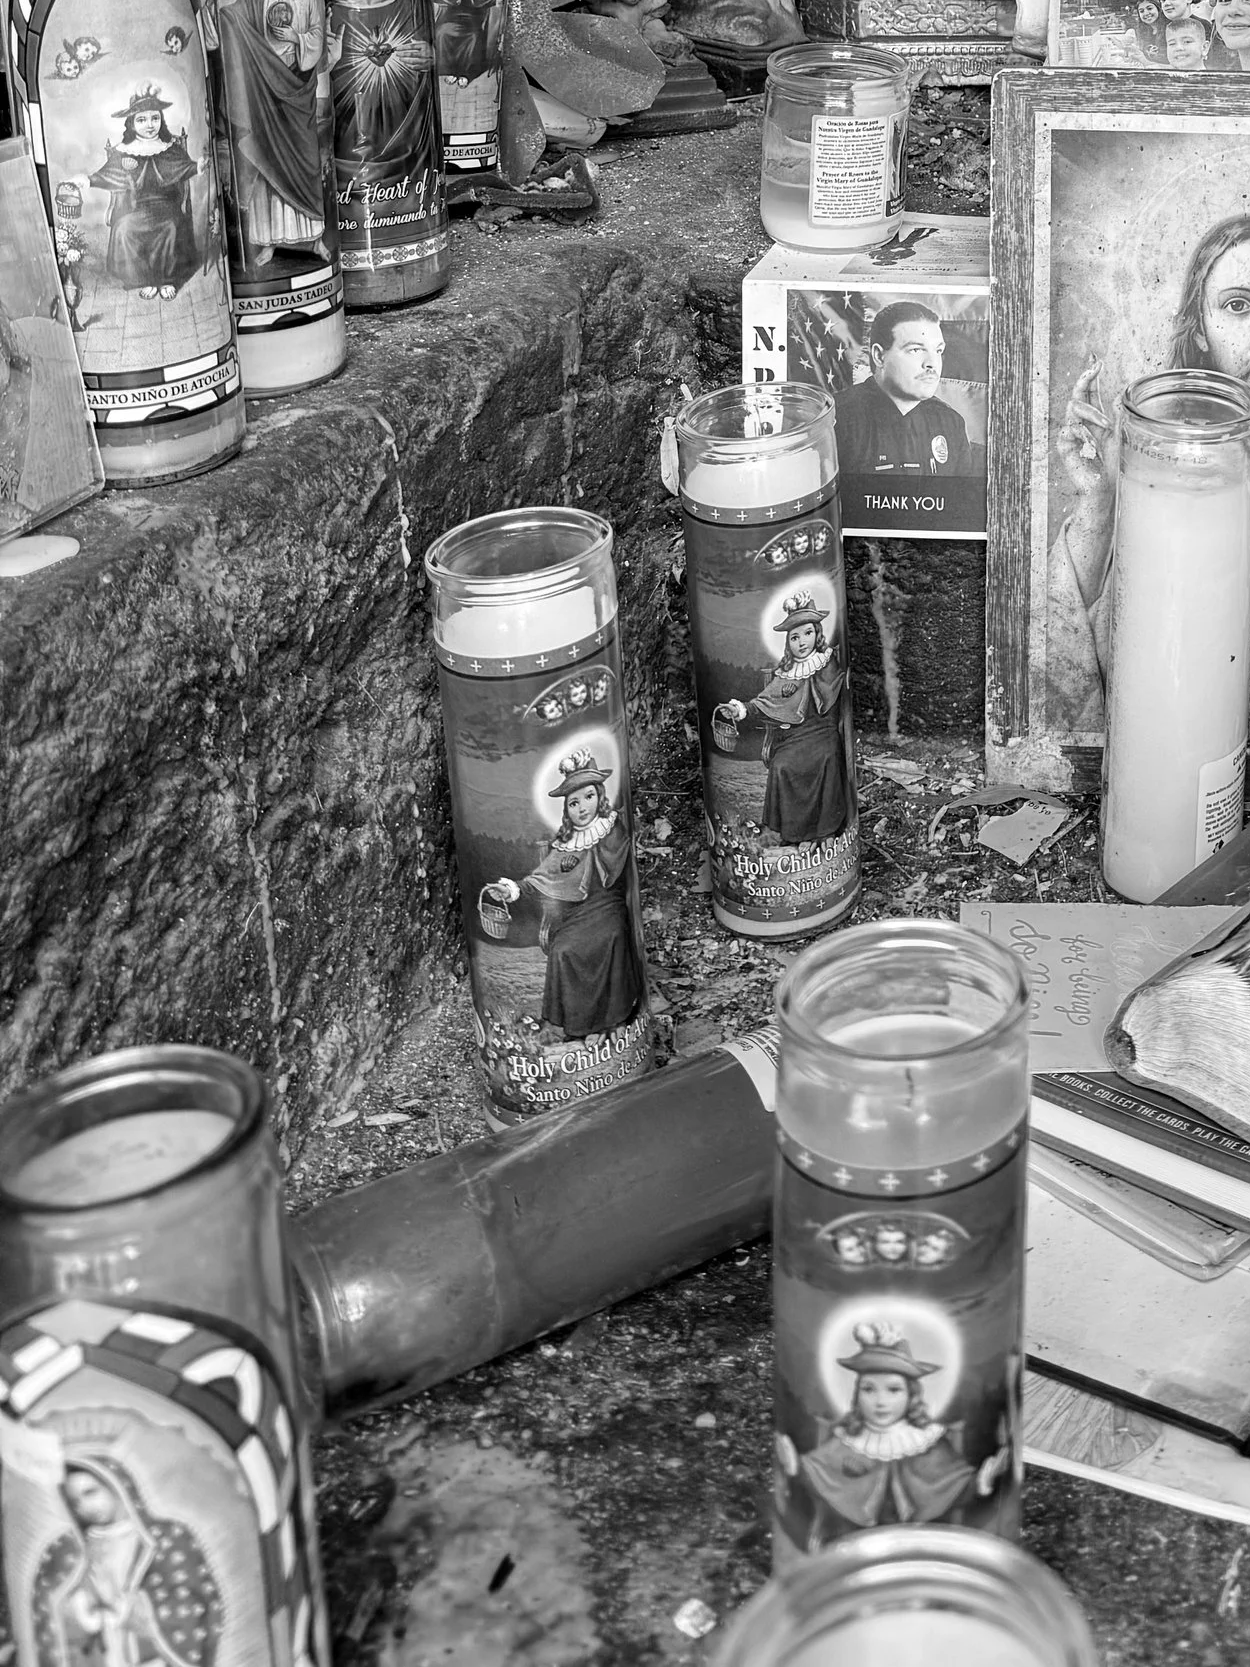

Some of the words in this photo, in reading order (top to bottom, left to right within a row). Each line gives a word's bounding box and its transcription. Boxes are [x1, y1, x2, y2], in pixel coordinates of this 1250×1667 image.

[452, 148, 464, 157] DE
[464, 146, 493, 156] ATOCHA
[361, 175, 410, 204] Heart
[415, 168, 428, 204] of
[364, 204, 427, 229] iluminando
[238, 297, 263, 311] SAN
[264, 292, 303, 311] JUDAS
[304, 283, 333, 301] TADEO
[753, 326, 786, 352] N.
[86, 392, 128, 406] SANTO
[131, 385, 168, 403] NIÑO
[171, 382, 188, 396] DE
[190, 368, 231, 391] ATOCHA
[864, 495, 908, 510] THANK
[912, 496, 945, 511] YOU
[736, 854, 774, 881] Holy
[777, 847, 822, 874] Child
[823, 837, 840, 862] of
[748, 881, 785, 897] Santo
[788, 877, 822, 896] Niño
[825, 867, 839, 883] de
[1060, 934, 1104, 965] for
[1054, 967, 1111, 1026] being
[511, 1055, 556, 1083] Holy
[561, 1039, 611, 1074] Child
[615, 1026, 632, 1054] of
[527, 1086, 571, 1103] Santo
[575, 1072, 613, 1098] Niño
[617, 1061, 631, 1080] de
[1059, 1074, 1093, 1093] BOOKS.
[1094, 1088, 1136, 1110] COLLECT
[1136, 1105, 1155, 1119] THE
[1155, 1113, 1190, 1132] CARDS.
[1192, 1127, 1218, 1144] PLAY
[1218, 1136, 1238, 1151] THE
